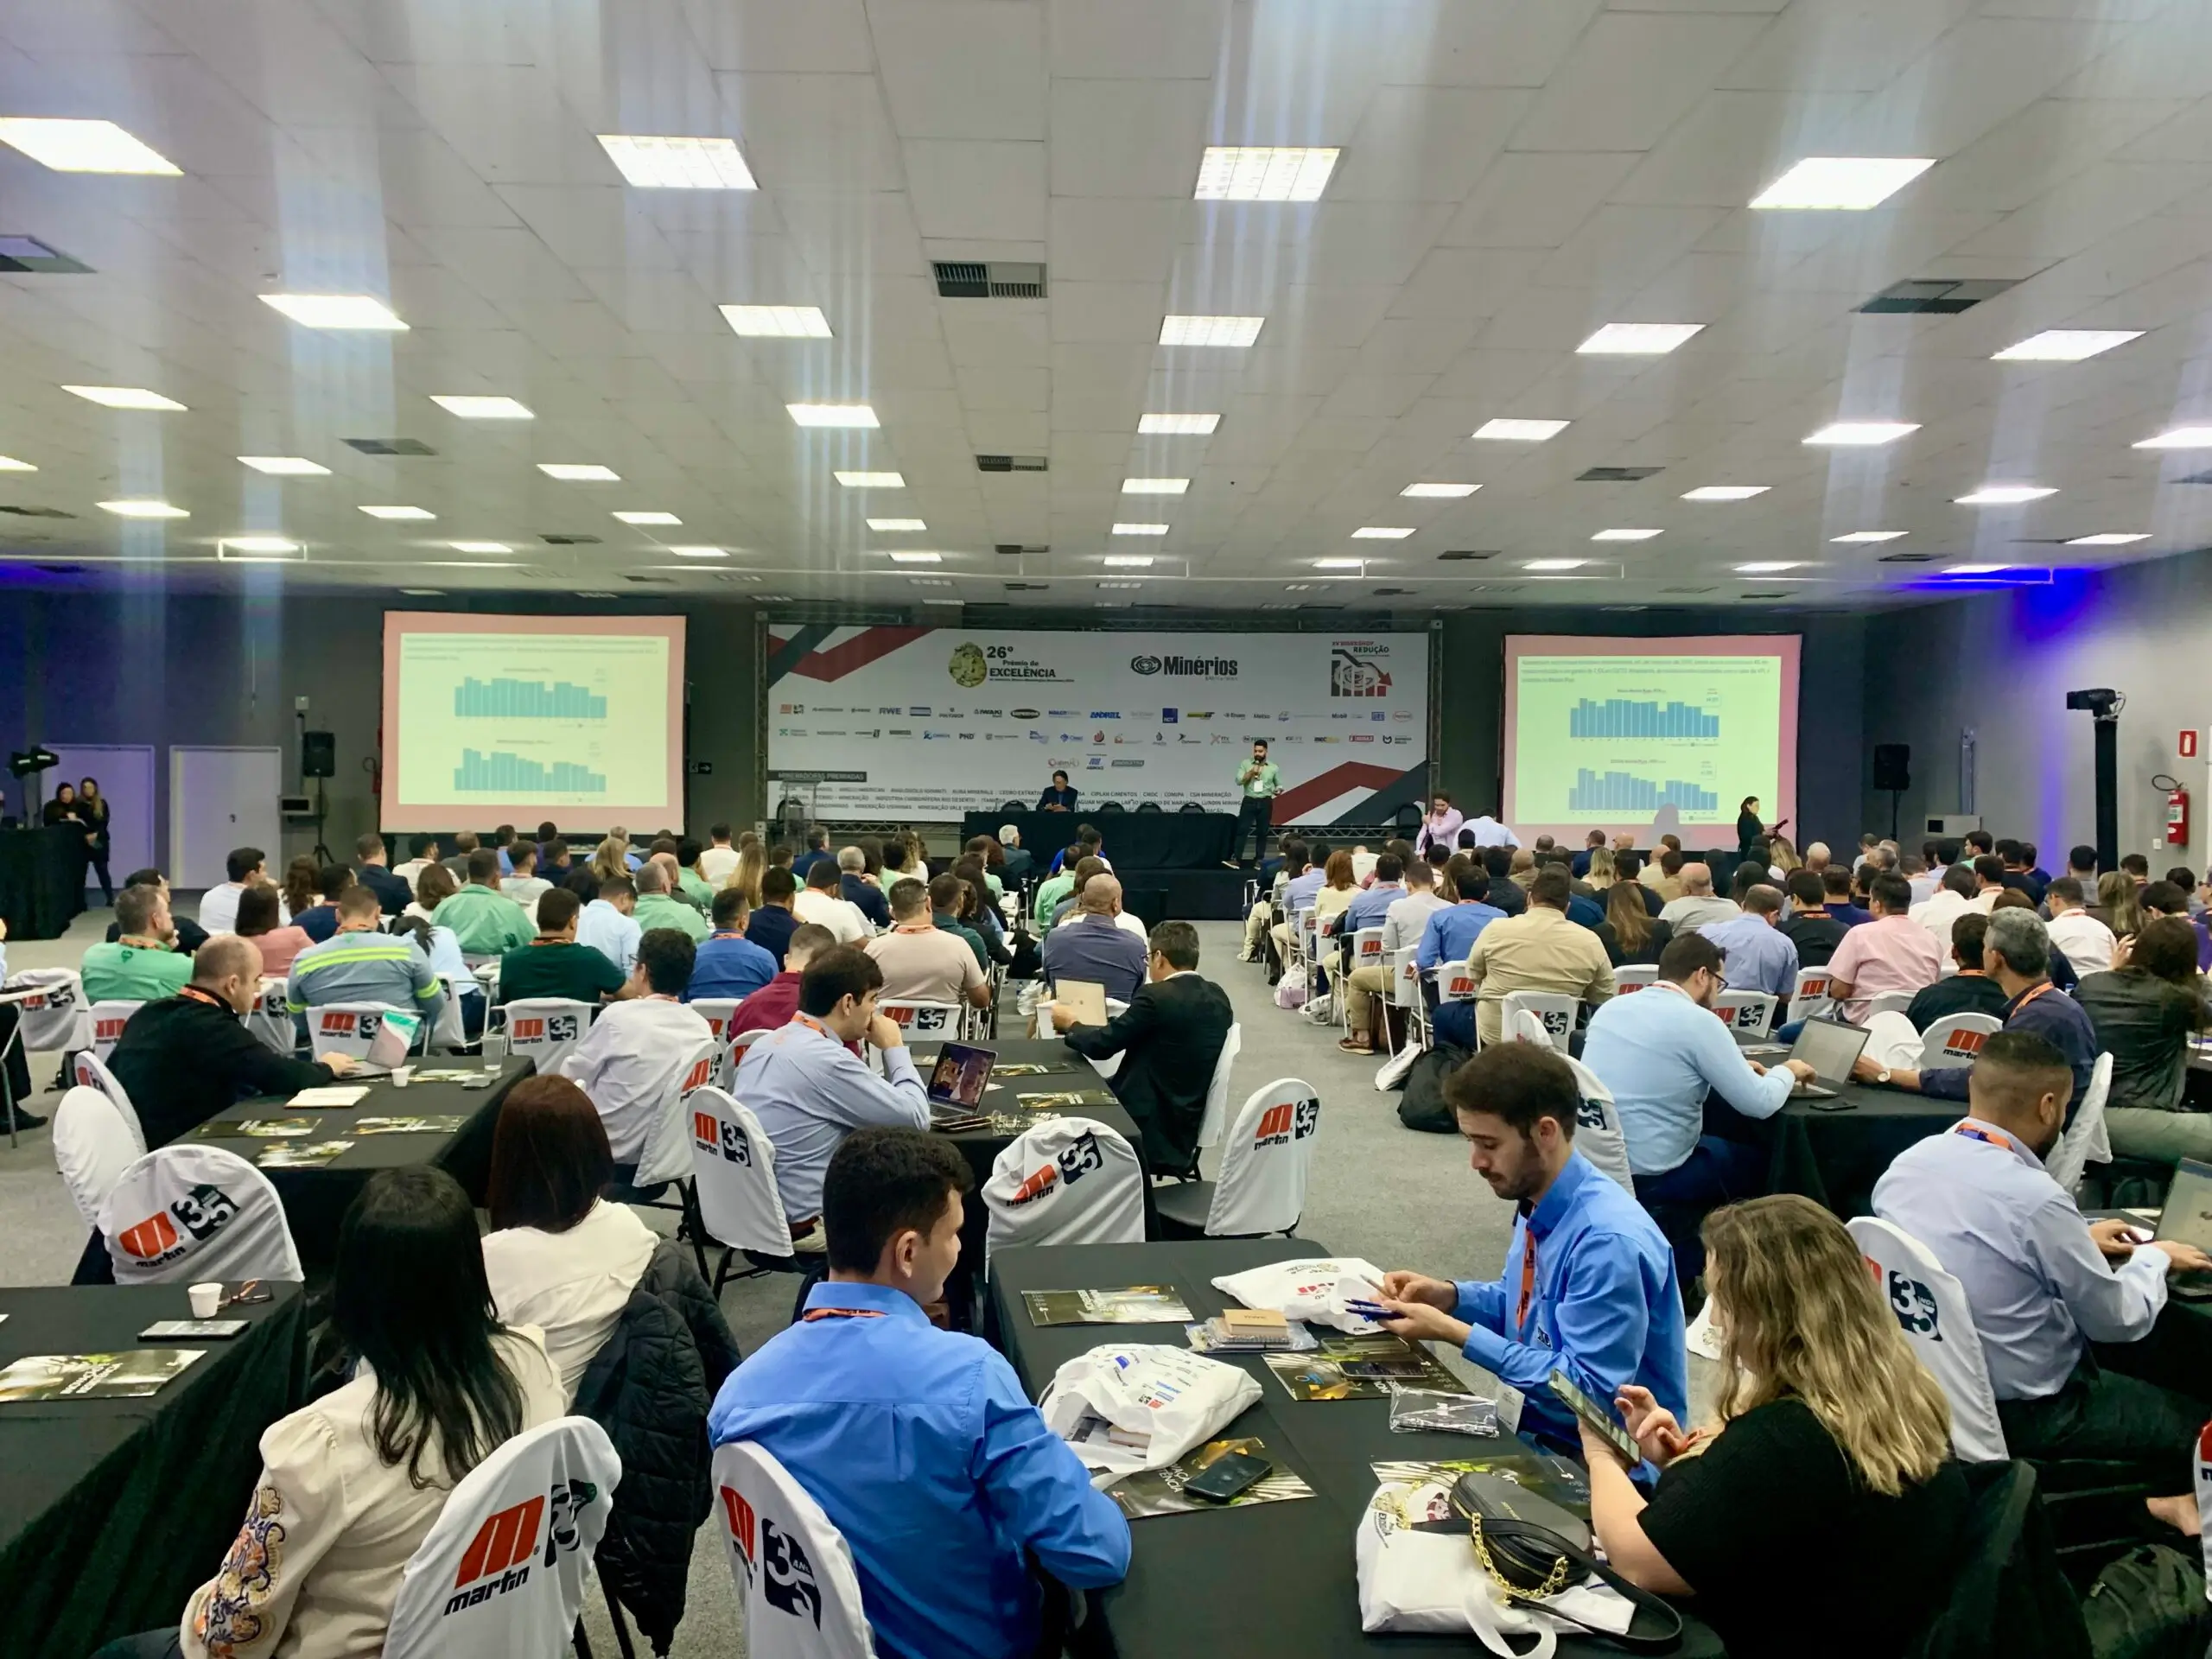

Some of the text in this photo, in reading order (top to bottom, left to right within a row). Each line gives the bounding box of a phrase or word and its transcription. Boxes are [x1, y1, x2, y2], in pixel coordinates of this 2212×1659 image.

[1353, 645, 1390, 654] REDUÇÃO
[989, 666, 1057, 677] EXCELÊNCIA
[1164, 656, 1238, 676] Minérios
[550, 1016, 576, 1040] 35
[919, 1008, 945, 1030] 35
[1545, 1012, 1568, 1034] 35
[1297, 1099, 1317, 1137] 35
[696, 1141, 718, 1156] martin
[723, 1122, 750, 1166] 35
[1255, 1135, 1288, 1151] martin
[1062, 1141, 1098, 1173] 35
[1006, 1185, 1054, 1207] martin
[176, 1195, 236, 1230] 35
[136, 1246, 187, 1268] martin
[1892, 1274, 1939, 1338] 35
[766, 1523, 817, 1618] 35
[443, 1566, 531, 1617] martin
